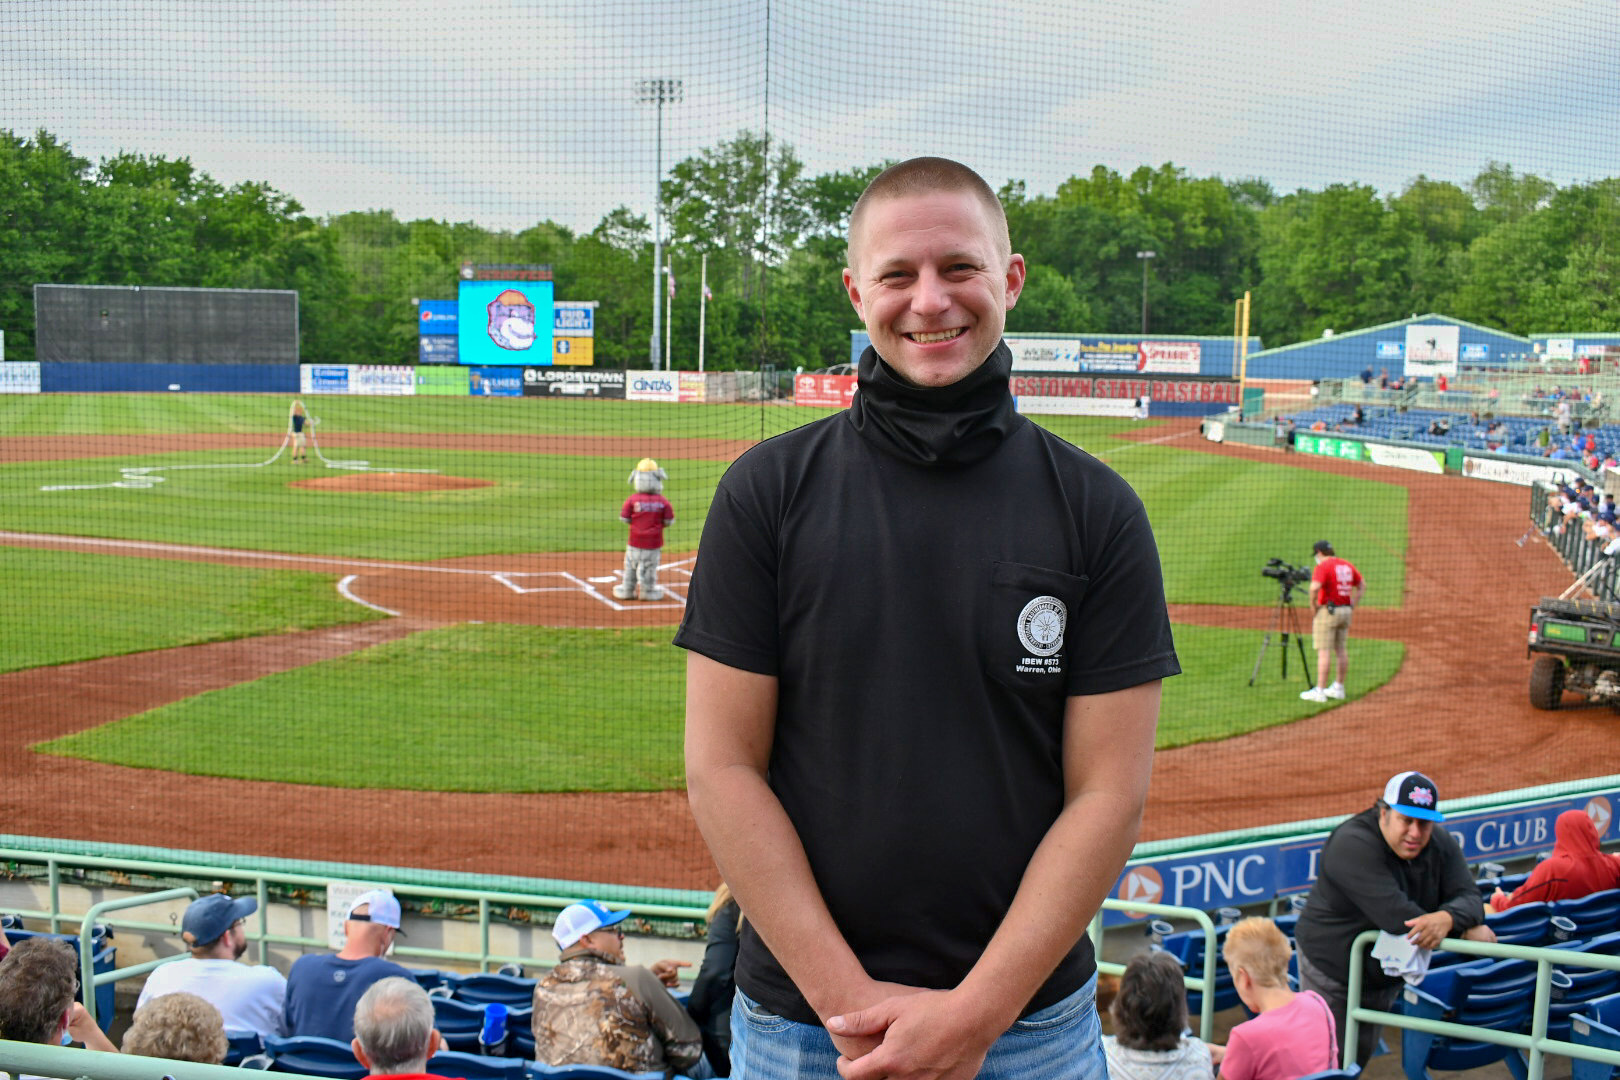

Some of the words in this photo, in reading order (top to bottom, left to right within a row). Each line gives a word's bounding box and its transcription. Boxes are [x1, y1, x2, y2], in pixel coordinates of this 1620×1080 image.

[556, 318, 590, 328] LIGHT
[537, 370, 624, 383] LORDSTOWN
[1095, 377, 1148, 399] STATE
[1151, 380, 1241, 404] BASEBALL
[1016, 665, 1046, 674] Warren,
[1475, 816, 1547, 852] CLUB
[1170, 854, 1266, 907] PNC
